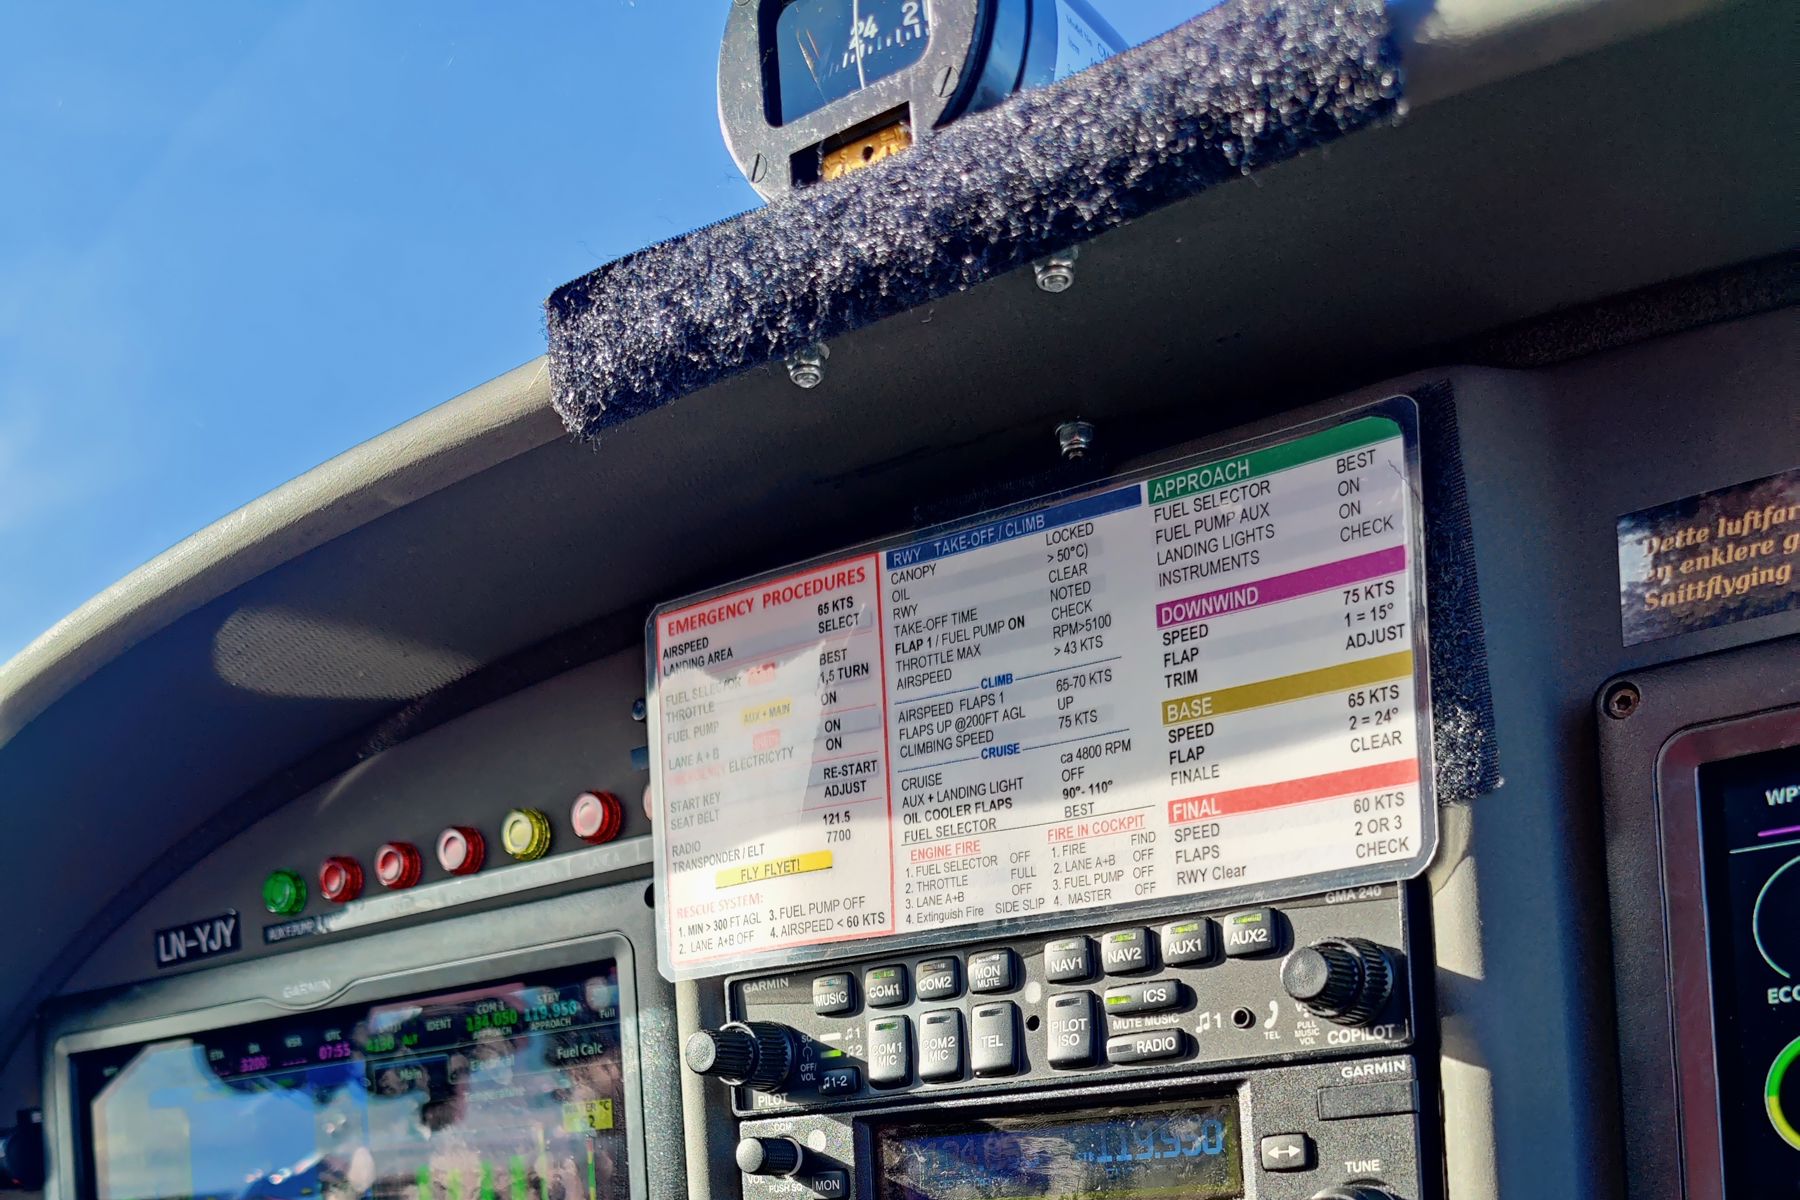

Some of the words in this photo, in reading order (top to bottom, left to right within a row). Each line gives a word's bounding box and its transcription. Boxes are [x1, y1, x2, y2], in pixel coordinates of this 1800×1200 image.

[1336, 450, 1376, 474] BEST
[1153, 459, 1250, 501] APPROACH
[1338, 479, 1360, 496] ON
[1154, 502, 1189, 523] FUEL
[1193, 480, 1271, 513] SELECTOR
[1339, 501, 1361, 519] ON
[1156, 524, 1190, 544] FUEL
[1194, 513, 1235, 534] PUMP
[1240, 502, 1270, 523] AUX
[1340, 515, 1394, 542] CHECK
[894, 549, 920, 566] RWY
[934, 528, 994, 555] TAKE-OFF
[1006, 515, 1045, 535] CLIMB
[1046, 523, 1094, 546] LOCKED
[1643, 527, 1709, 558] Dette
[1157, 538, 1219, 566] LANDING
[1223, 524, 1275, 550] LIGHTS
[1679, 538, 1774, 574] enklere
[891, 564, 937, 585] CANOPY
[1159, 550, 1260, 587] INSTRUMENTS
[1343, 589, 1360, 605] 75
[1364, 581, 1394, 599] KTS
[1644, 563, 1792, 611] Snittflyging
[668, 598, 753, 636] EMERGENCY
[763, 566, 865, 609] PROCEDURES
[818, 602, 829, 616] 65
[832, 596, 853, 612] KTS
[1051, 599, 1092, 621] CHECK
[1161, 587, 1258, 625] DOWNWIND
[818, 613, 860, 633] SELECT
[894, 616, 948, 638] TAKE-OFF
[952, 608, 978, 624] TIME
[895, 639, 920, 655] FLAP
[923, 637, 931, 650] 1
[942, 627, 970, 645] FUEL
[973, 621, 1004, 639] PUMP
[1008, 616, 1025, 631] ON
[1163, 624, 1209, 646] SPEED
[1346, 623, 1405, 650] ADJUST
[663, 636, 709, 660] AIRSPEED
[837, 662, 869, 680] TURN
[1165, 669, 1198, 689] TRIM
[981, 674, 1013, 690] CLIMB
[1348, 693, 1364, 708] 65
[1369, 685, 1399, 704] KTS
[1167, 697, 1213, 723] BASE
[900, 738, 953, 758] CLIMBING
[956, 730, 994, 748] SPEED
[981, 743, 1021, 760] CRUISE
[823, 760, 877, 780] RE-START
[824, 781, 866, 799] ADJUST
[1765, 785, 1800, 806] WP
[823, 811, 850, 826] 121.5
[903, 811, 920, 826] OIL
[924, 803, 972, 821] COOLER
[975, 798, 1012, 814] FLAPS
[1173, 801, 1221, 822] FINAL
[1356, 836, 1409, 859] CHECK
[741, 867, 758, 881] FLY
[1177, 868, 1207, 886] RWY
[1213, 864, 1246, 881] Clear
[1325, 890, 1355, 904] GMA
[1359, 885, 1381, 899] 240
[770, 927, 778, 938] 4.
[781, 917, 833, 937] AIRSPEED
[847, 916, 859, 927] 60
[863, 912, 884, 926] KTS
[159, 917, 235, 963] LN-YJY
[1230, 929, 1267, 944] AUX2
[1168, 939, 1202, 954] AUX1
[1051, 957, 1082, 972] NAV1
[1107, 948, 1141, 964] NAV2
[975, 964, 1000, 979] MON
[743, 978, 789, 993] GARMIN
[869, 985, 900, 998] COM1
[918, 977, 952, 991] COM2
[978, 978, 1000, 988] MUTE
[815, 991, 847, 1006] MUSIC
[1143, 989, 1166, 1002] ICS
[1051, 1018, 1087, 1032] PILOT
[1113, 1018, 1141, 1030] MUTE
[1145, 1015, 1179, 1026] MUSIC
[1296, 1021, 1317, 1030] PULL
[981, 1035, 1003, 1048] TEL
[1057, 1033, 1079, 1047] ISO
[1264, 1031, 1280, 1040] TEL
[1294, 1028, 1320, 1038] MUSIC
[1299, 1036, 1316, 1046] VOL
[1327, 1024, 1395, 1045] COPILOT
[557, 1045, 579, 1060] Fuel
[581, 1042, 603, 1056] Calc
[923, 1037, 955, 1049] COM2
[1136, 1038, 1175, 1053] RADIO
[877, 1054, 897, 1066] MIC
[929, 1049, 948, 1062] MIC
[800, 1062, 817, 1073] OFF/
[1341, 1061, 1405, 1078] GARMIN
[800, 1072, 816, 1082] VOL
[758, 1093, 787, 1107] PILOT
[1345, 1160, 1380, 1173] TUNE
[815, 1179, 840, 1192] MON
